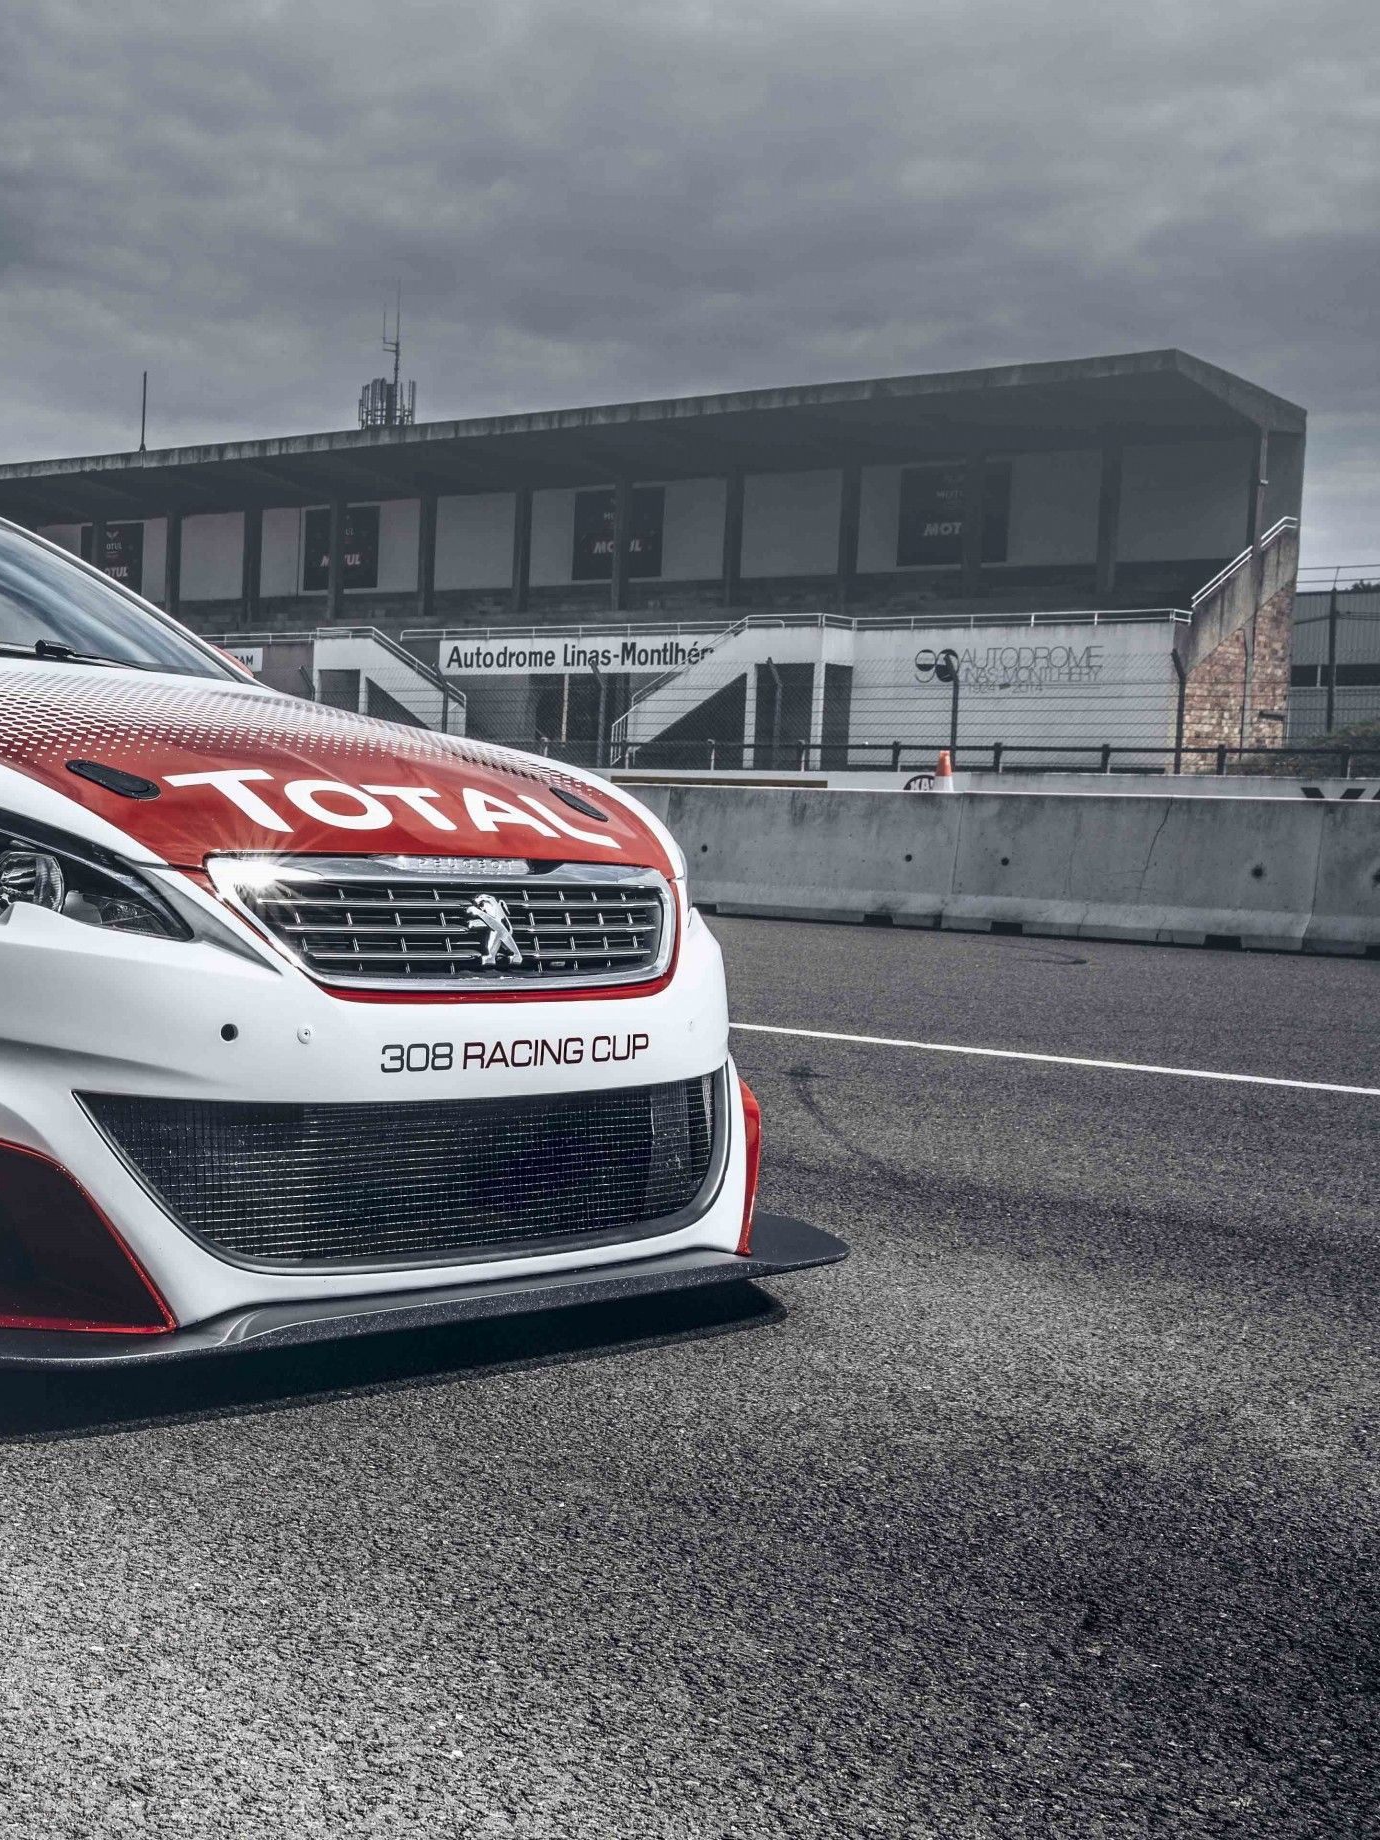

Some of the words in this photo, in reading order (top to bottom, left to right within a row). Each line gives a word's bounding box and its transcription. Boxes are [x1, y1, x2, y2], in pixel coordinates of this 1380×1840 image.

[321, 553, 360, 566] MUL
[446, 645, 556, 669] Autodrome
[960, 645, 1104, 668] AUTODROME
[162, 769, 622, 848] TOTAL
[380, 1042, 454, 1073] 308
[462, 1037, 584, 1069] RACING
[592, 1033, 649, 1062] CUP
